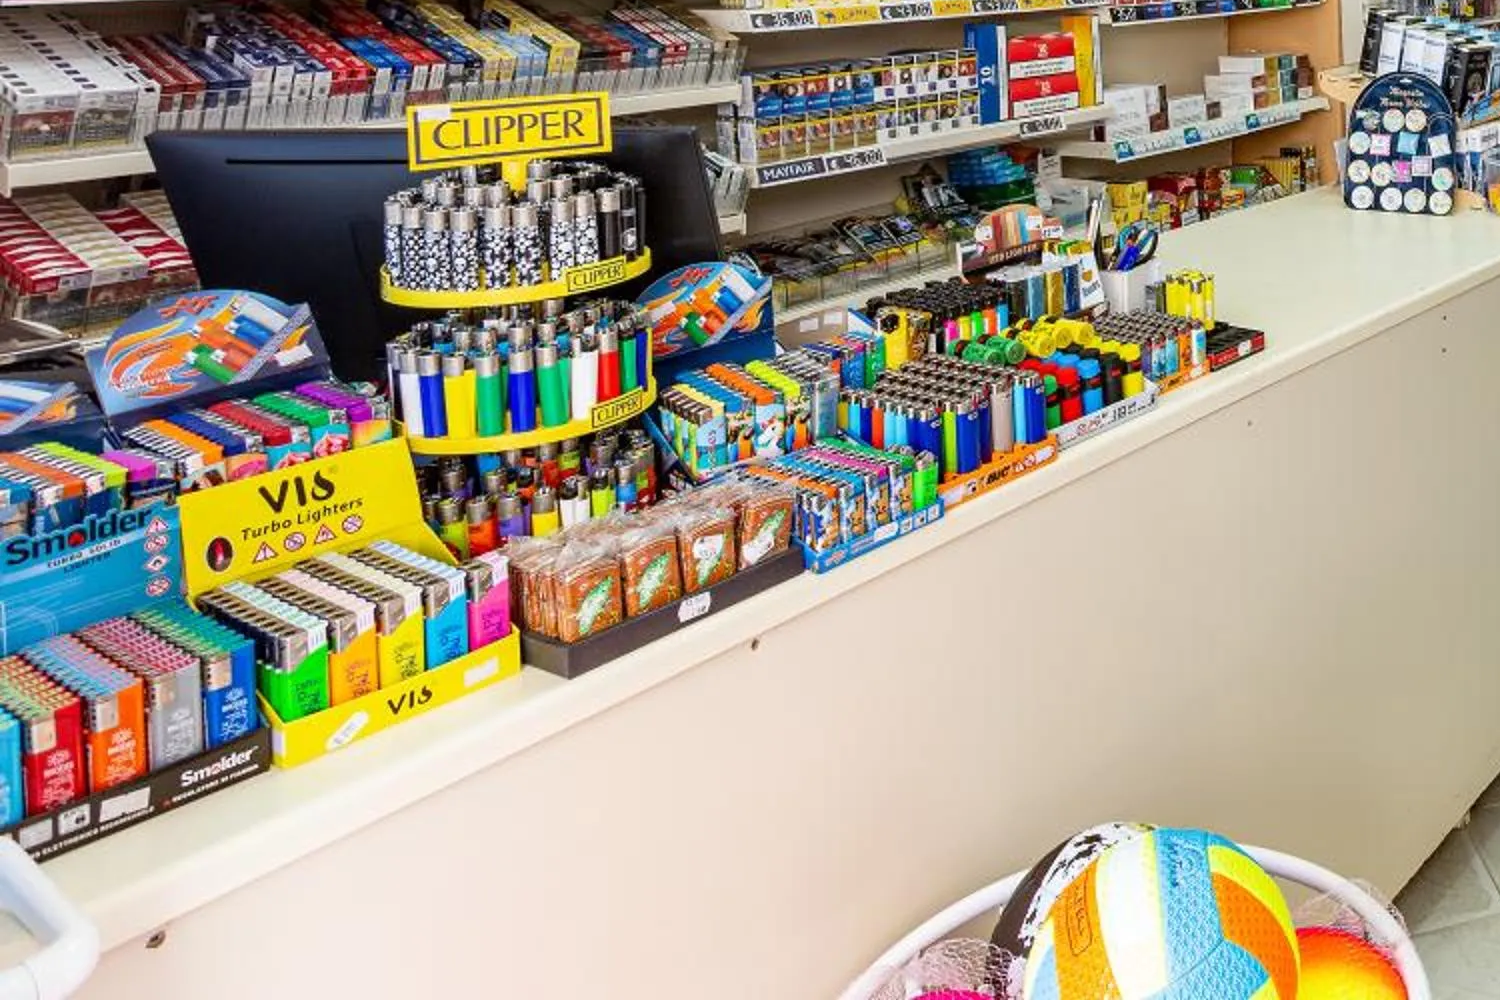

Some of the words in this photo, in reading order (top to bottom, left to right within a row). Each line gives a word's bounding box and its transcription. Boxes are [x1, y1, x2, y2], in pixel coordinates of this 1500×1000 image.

[432, 109, 586, 151] CLIPPER
[763, 162, 816, 181] MAYFAIR
[572, 265, 622, 288] CLIPPER
[596, 398, 641, 423] CLIPPER
[258, 470, 336, 514] VIS
[7, 507, 151, 566] Smolder
[241, 518, 293, 542] Turbo
[296, 497, 364, 526] Lighters
[386, 684, 434, 715] VIS
[180, 748, 253, 787] Smolder
